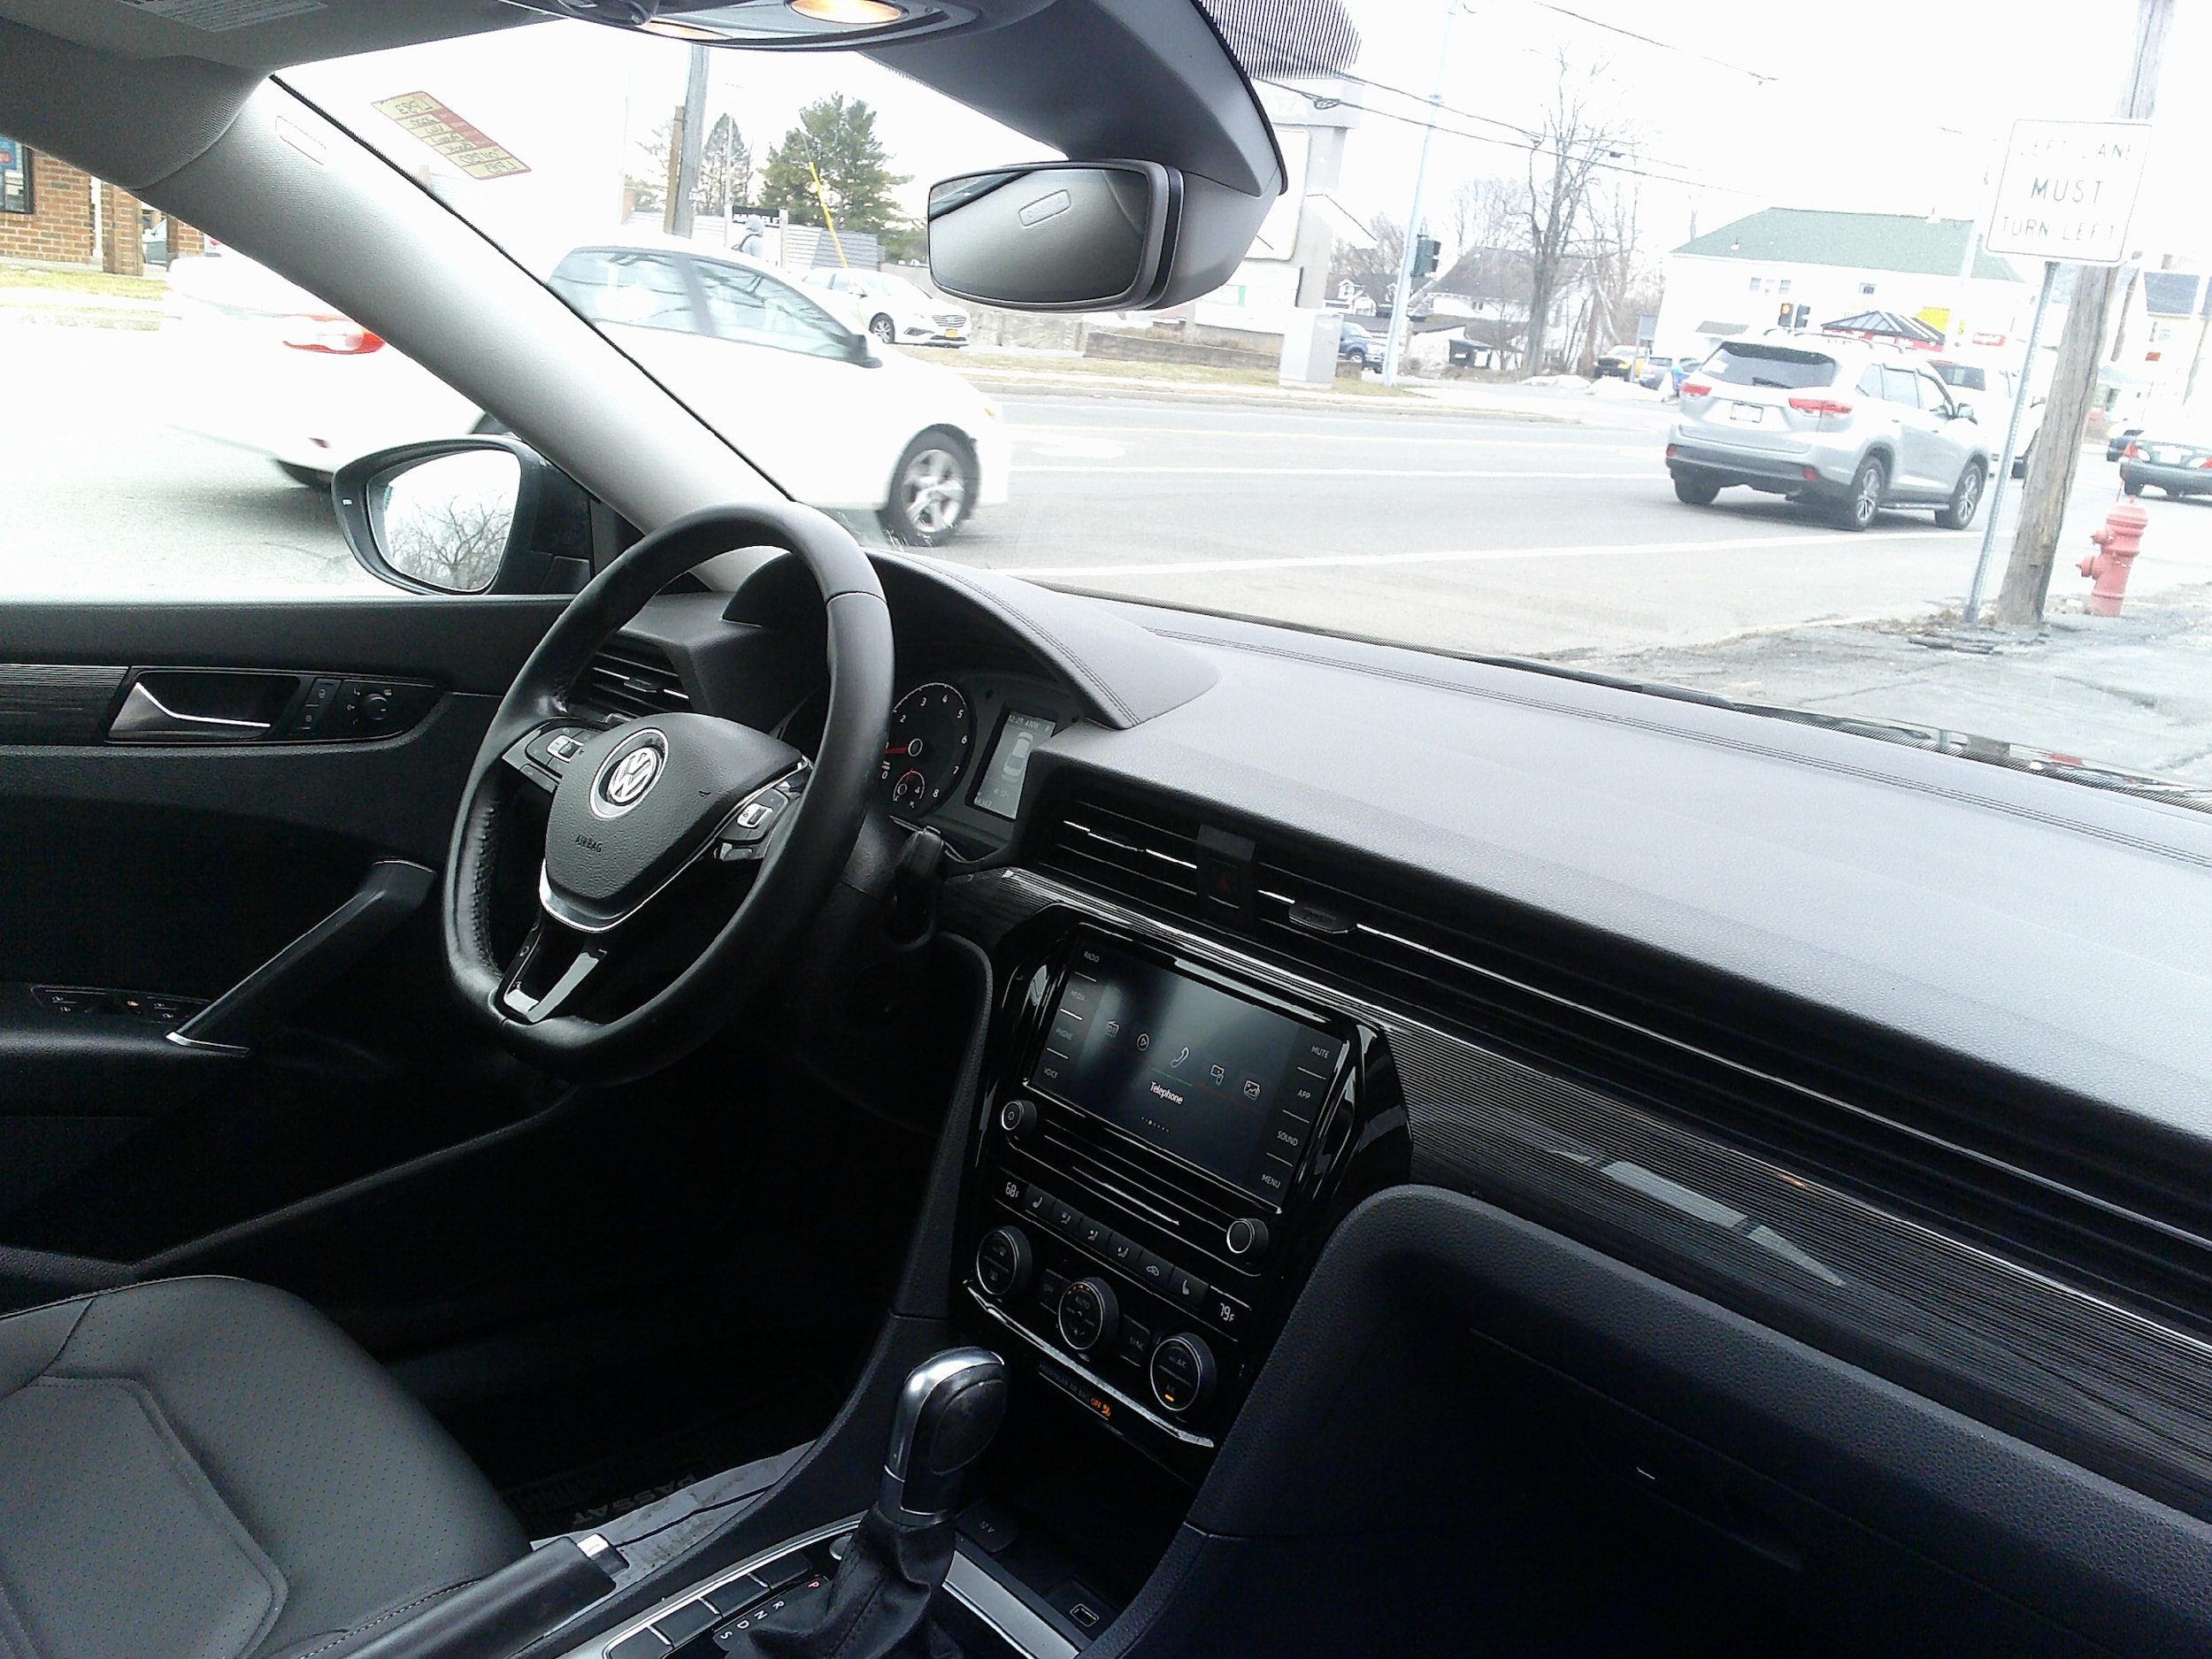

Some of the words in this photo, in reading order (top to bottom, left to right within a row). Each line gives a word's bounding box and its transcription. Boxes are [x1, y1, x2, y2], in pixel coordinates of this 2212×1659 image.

[2018, 138, 2067, 157] EFT
[2081, 142, 2132, 161] AN
[2030, 177, 2104, 204] MUST
[2002, 216, 2051, 238] TURN
[2062, 221, 2115, 242] LEFT
[920, 697, 927, 707] 3
[941, 695, 949, 703] 4
[899, 714, 907, 723] 2
[956, 709, 964, 718] 5
[961, 734, 968, 744] 6
[952, 765, 960, 775] 7
[933, 788, 940, 798] 8
[574, 834, 603, 853] AIRBAG
[1083, 949, 1101, 964] RADIO
[1310, 1045, 1331, 1059] MUTE
[1042, 1066, 1059, 1079] VOICE
[1150, 1081, 1183, 1105] Telephone
[1296, 1088, 1311, 1100] APP
[1276, 1130, 1300, 1147] SOUND
[1261, 1173, 1281, 1189] MENU
[572, 1472, 697, 1527] PASSAT
[808, 1580, 820, 1589] P
[772, 1600, 785, 1610] R
[754, 1609, 768, 1621] N
[736, 1619, 750, 1630] D
[720, 1630, 733, 1640] S
